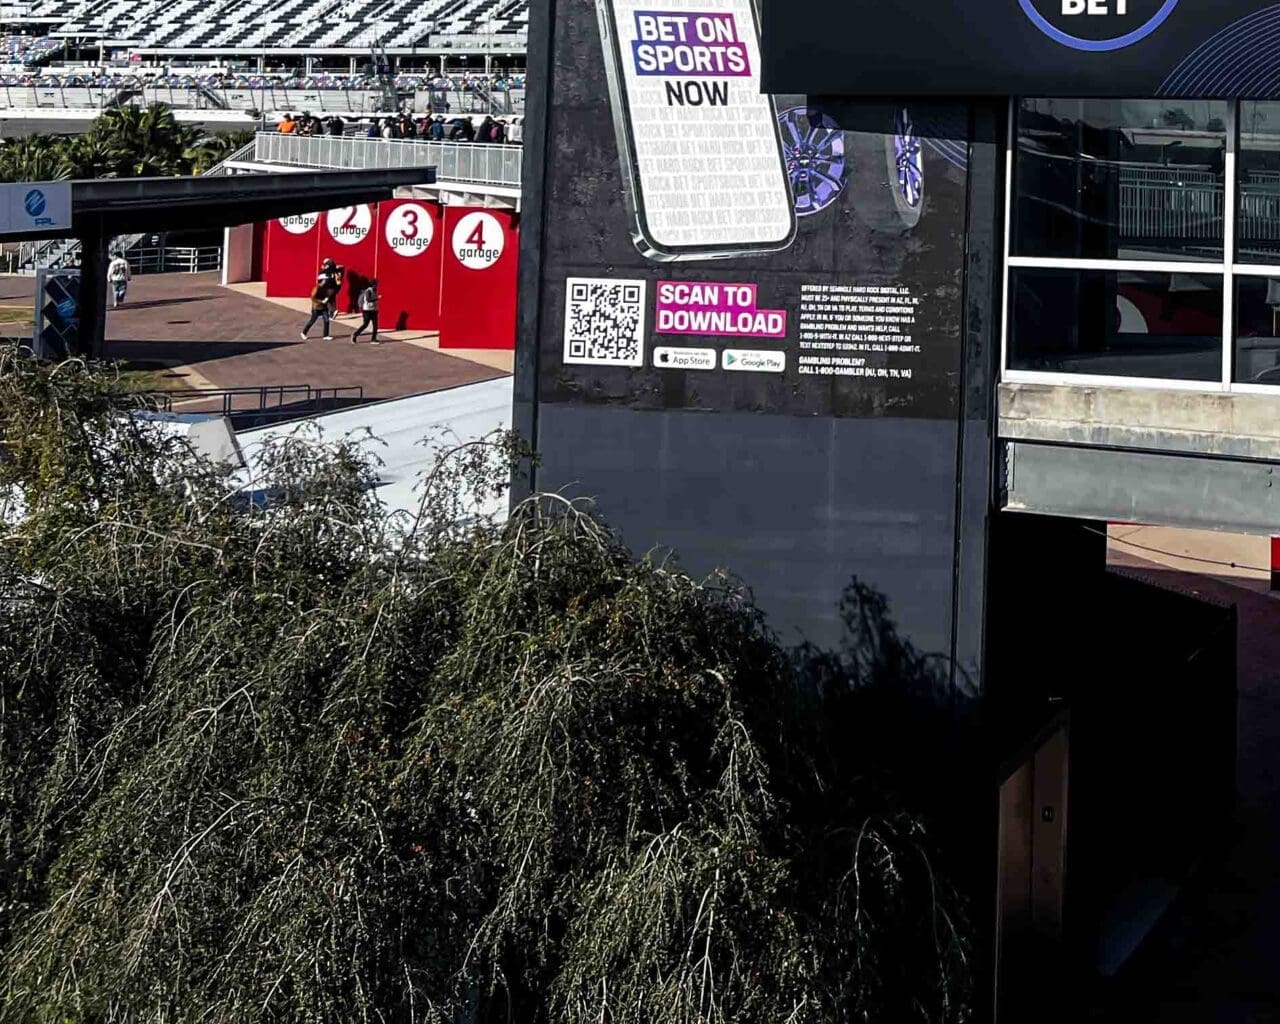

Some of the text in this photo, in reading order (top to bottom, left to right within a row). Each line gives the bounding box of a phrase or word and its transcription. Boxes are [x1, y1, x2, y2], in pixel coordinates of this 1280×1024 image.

[638, 15, 734, 43] BET ON
[637, 44, 746, 72] SPORTS
[664, 80, 729, 106] NOW
[283, 216, 315, 227] garage
[341, 204, 357, 229] 2
[400, 209, 418, 239] 3
[332, 226, 367, 238] garage
[392, 236, 429, 250] garage
[465, 219, 486, 249] 4
[459, 247, 500, 262] garage
[660, 284, 752, 307] SCAN TO
[659, 310, 783, 334] DOWNLOAD
[672, 356, 711, 366] App Store
[741, 358, 781, 368] Google Play
[798, 365, 814, 374] CALL
